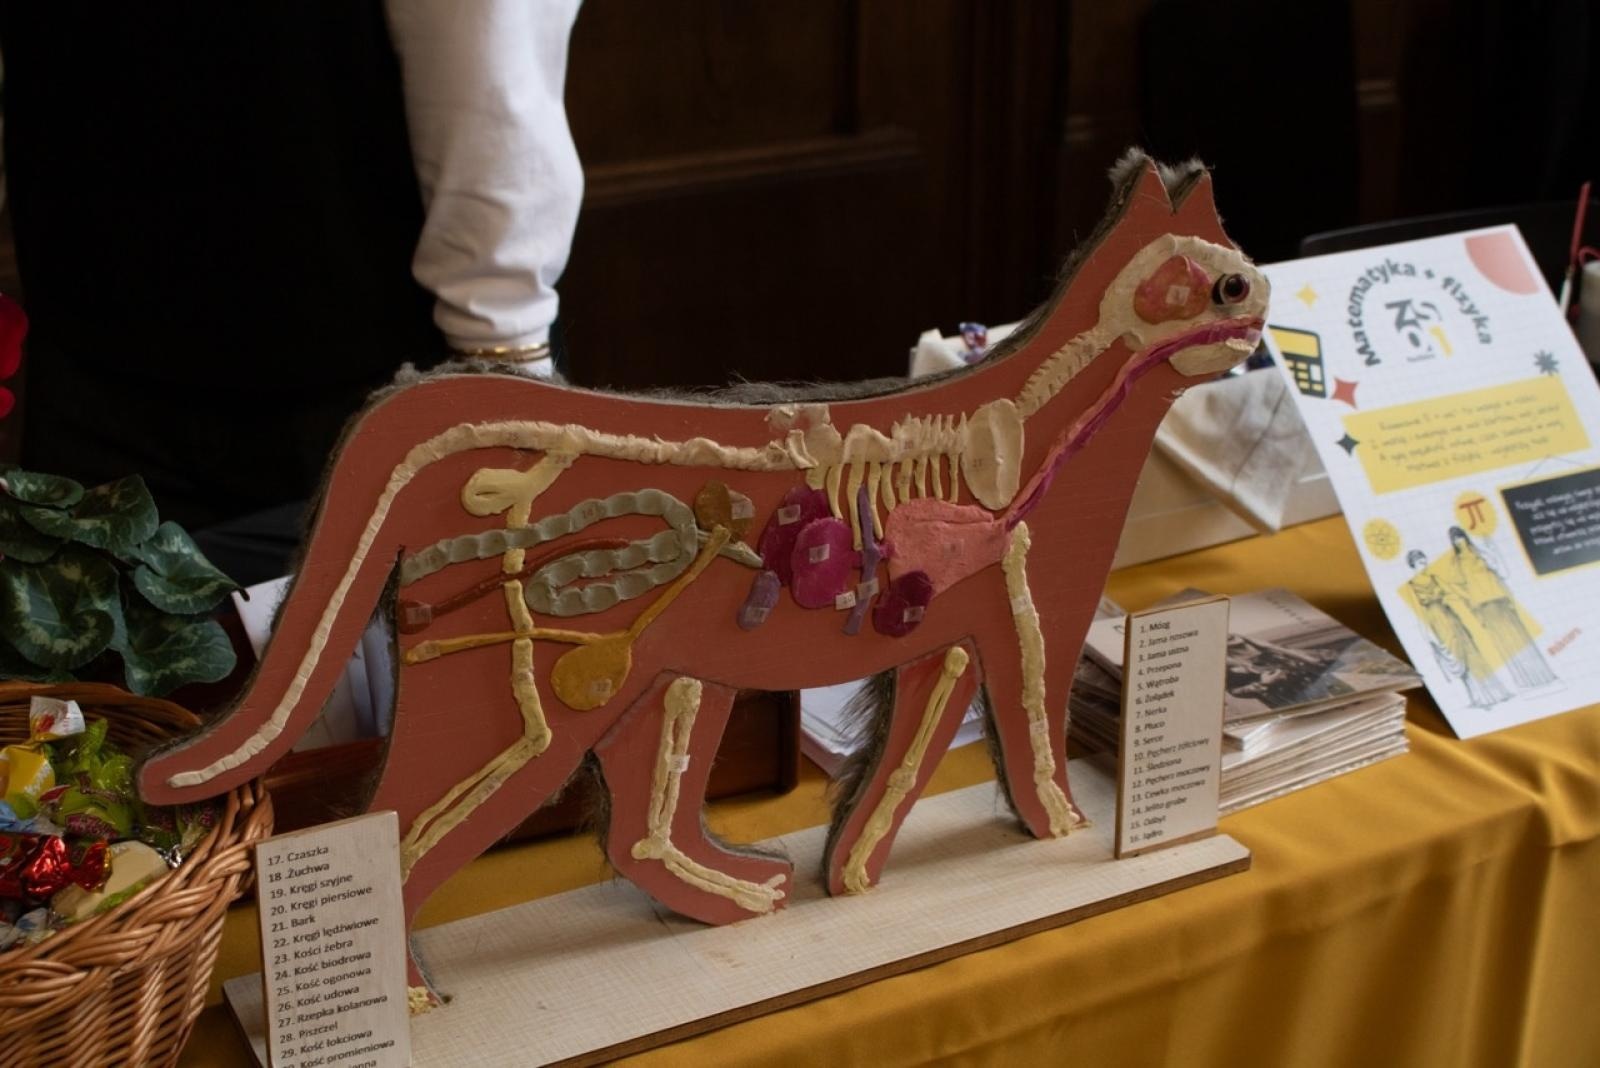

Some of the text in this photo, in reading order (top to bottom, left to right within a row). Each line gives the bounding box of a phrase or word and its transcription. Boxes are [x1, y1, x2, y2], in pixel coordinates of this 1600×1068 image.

[1347, 258, 1416, 367] Matematyka
[268, 846, 329, 866] 17. Czaszka
[270, 874, 353, 899] 19. Kręgi szyjne
[270, 886, 372, 916] 20. Kręgi piersiowe
[272, 915, 316, 932] 21. Bark
[273, 917, 379, 948] 22. Kręgi lędźwiowe
[274, 940, 353, 964] 23. Kości żebra
[275, 952, 372, 980] 24. Kość biodrowa
[276, 967, 372, 996] 25. Kość ogonowa
[278, 986, 360, 1012] 26. Kość udowa
[278, 994, 388, 1028] 27. Rzepka kolanowa
[280, 1022, 338, 1044] 28. Piszczel
[281, 1030, 373, 1059] 29. Kość łokciowa
[326, 1040, 395, 1064] promieniowa
